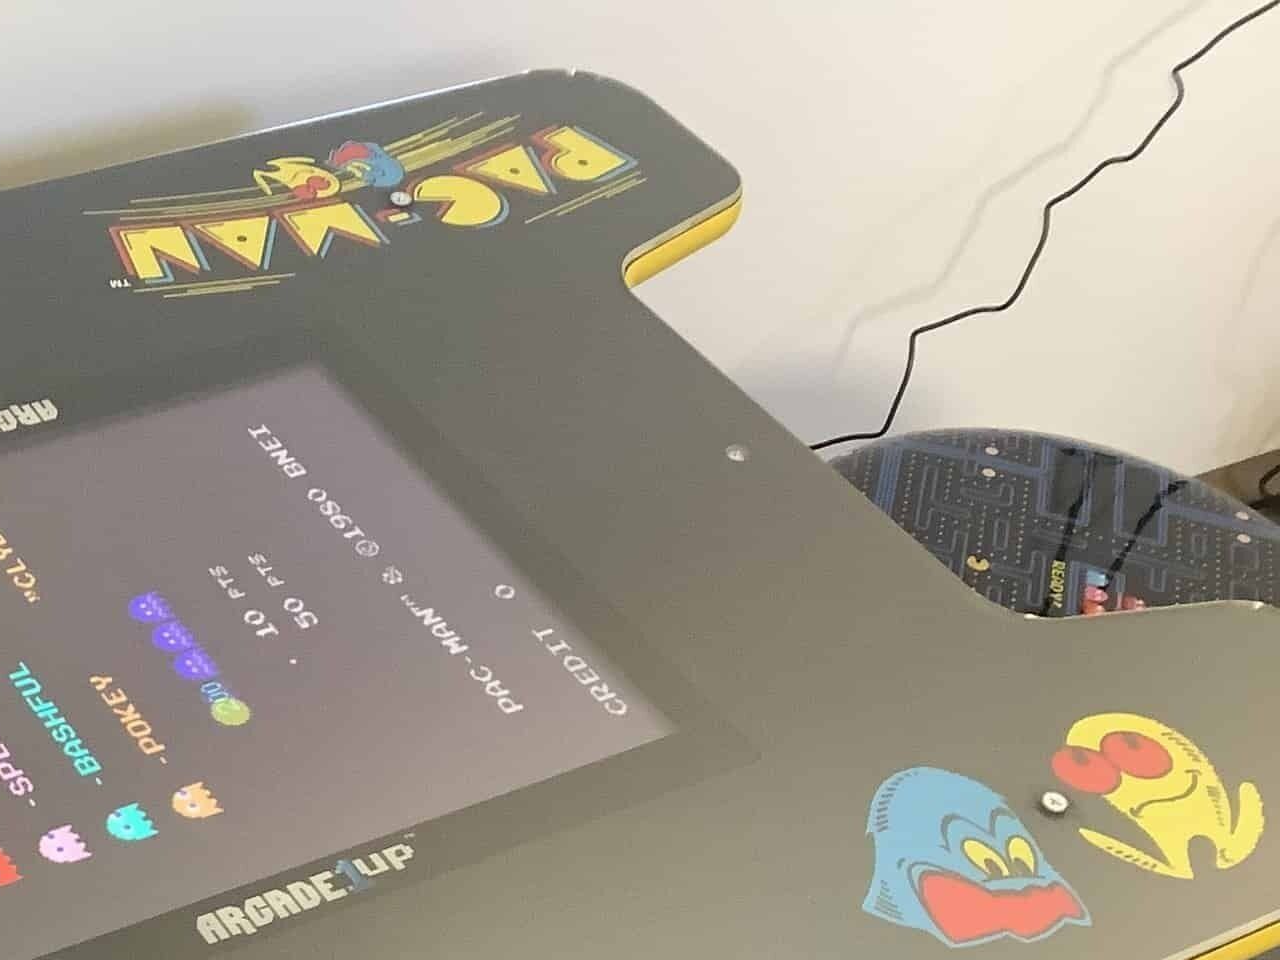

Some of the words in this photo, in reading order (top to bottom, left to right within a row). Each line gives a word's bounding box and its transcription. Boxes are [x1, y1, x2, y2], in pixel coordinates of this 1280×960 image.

[108, 123, 639, 283] PAC-MAN
[248, 423, 307, 479] BNEI
[243, 609, 280, 638] 10
[283, 597, 319, 631] 50
[531, 626, 628, 717] CREDIT
